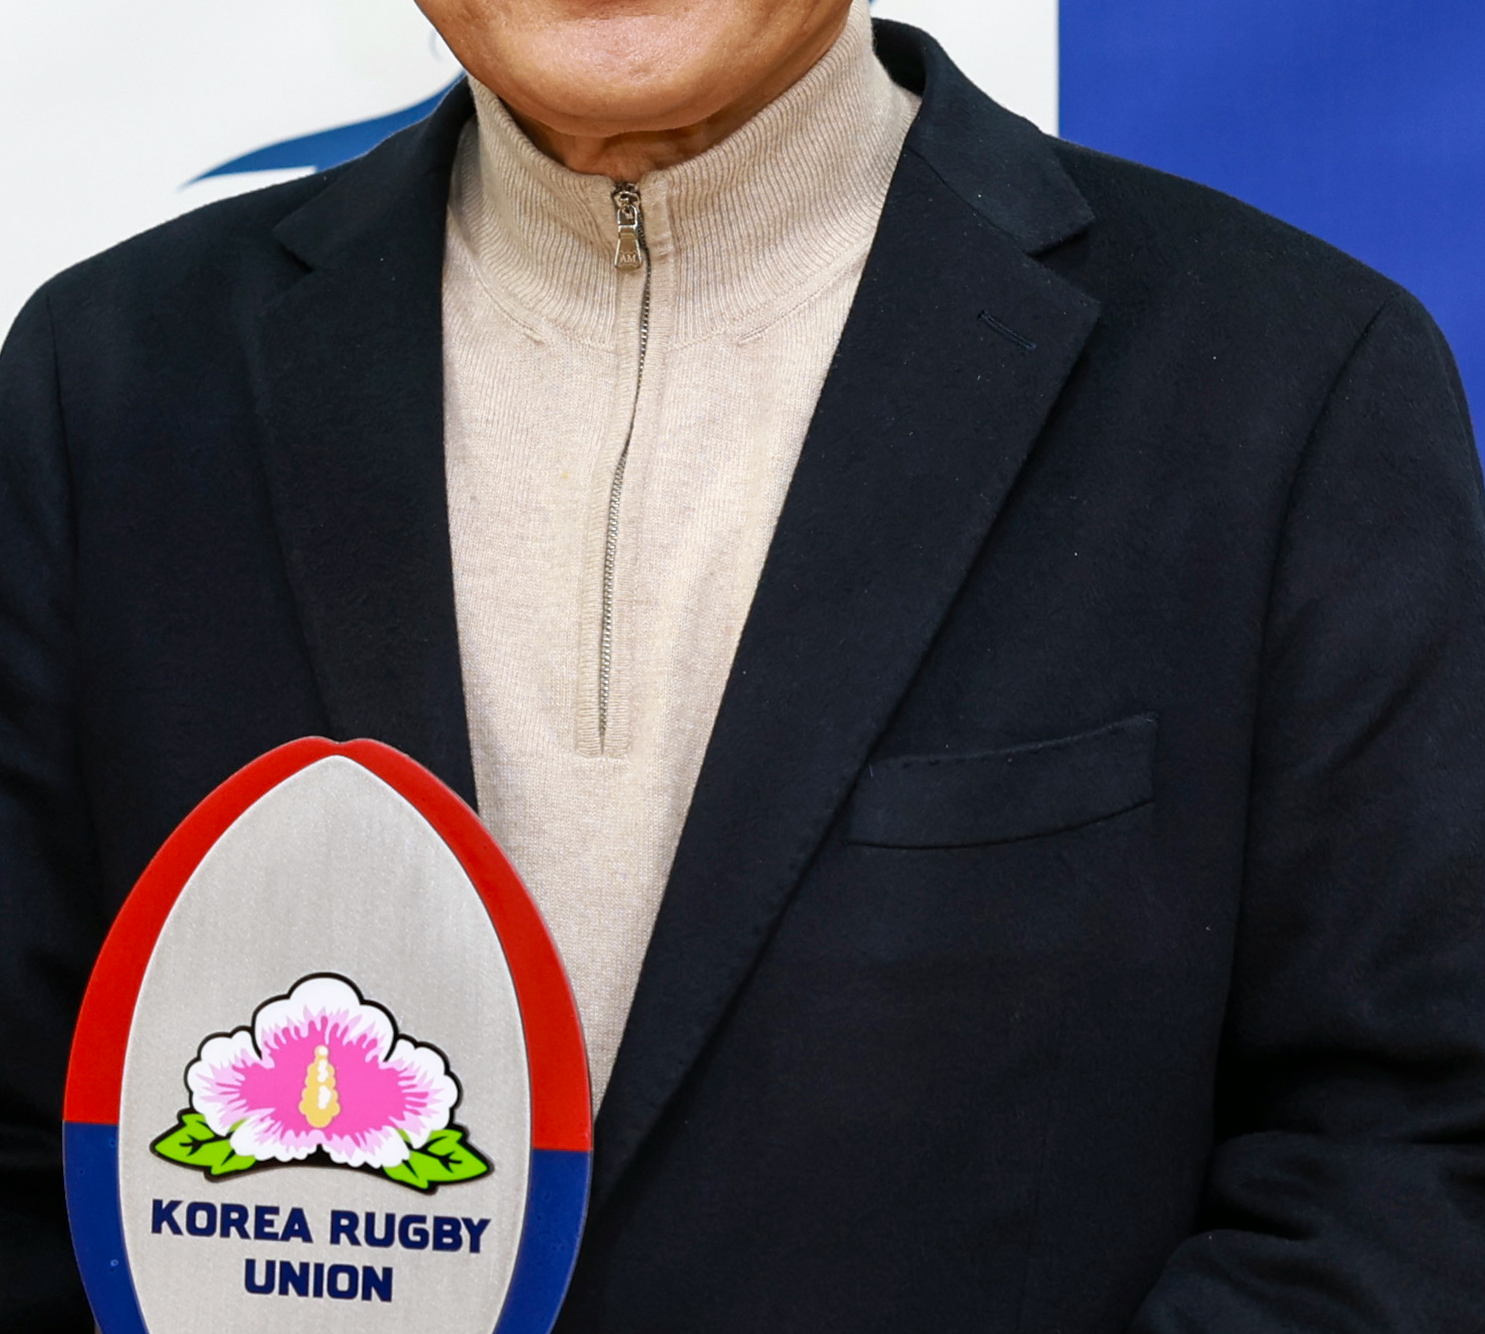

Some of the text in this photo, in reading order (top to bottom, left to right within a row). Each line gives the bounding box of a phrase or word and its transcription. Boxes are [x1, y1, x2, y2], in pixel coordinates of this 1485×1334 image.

[150, 1198, 491, 1255] KOREA RUGBY
[243, 1257, 394, 1303] UNION
